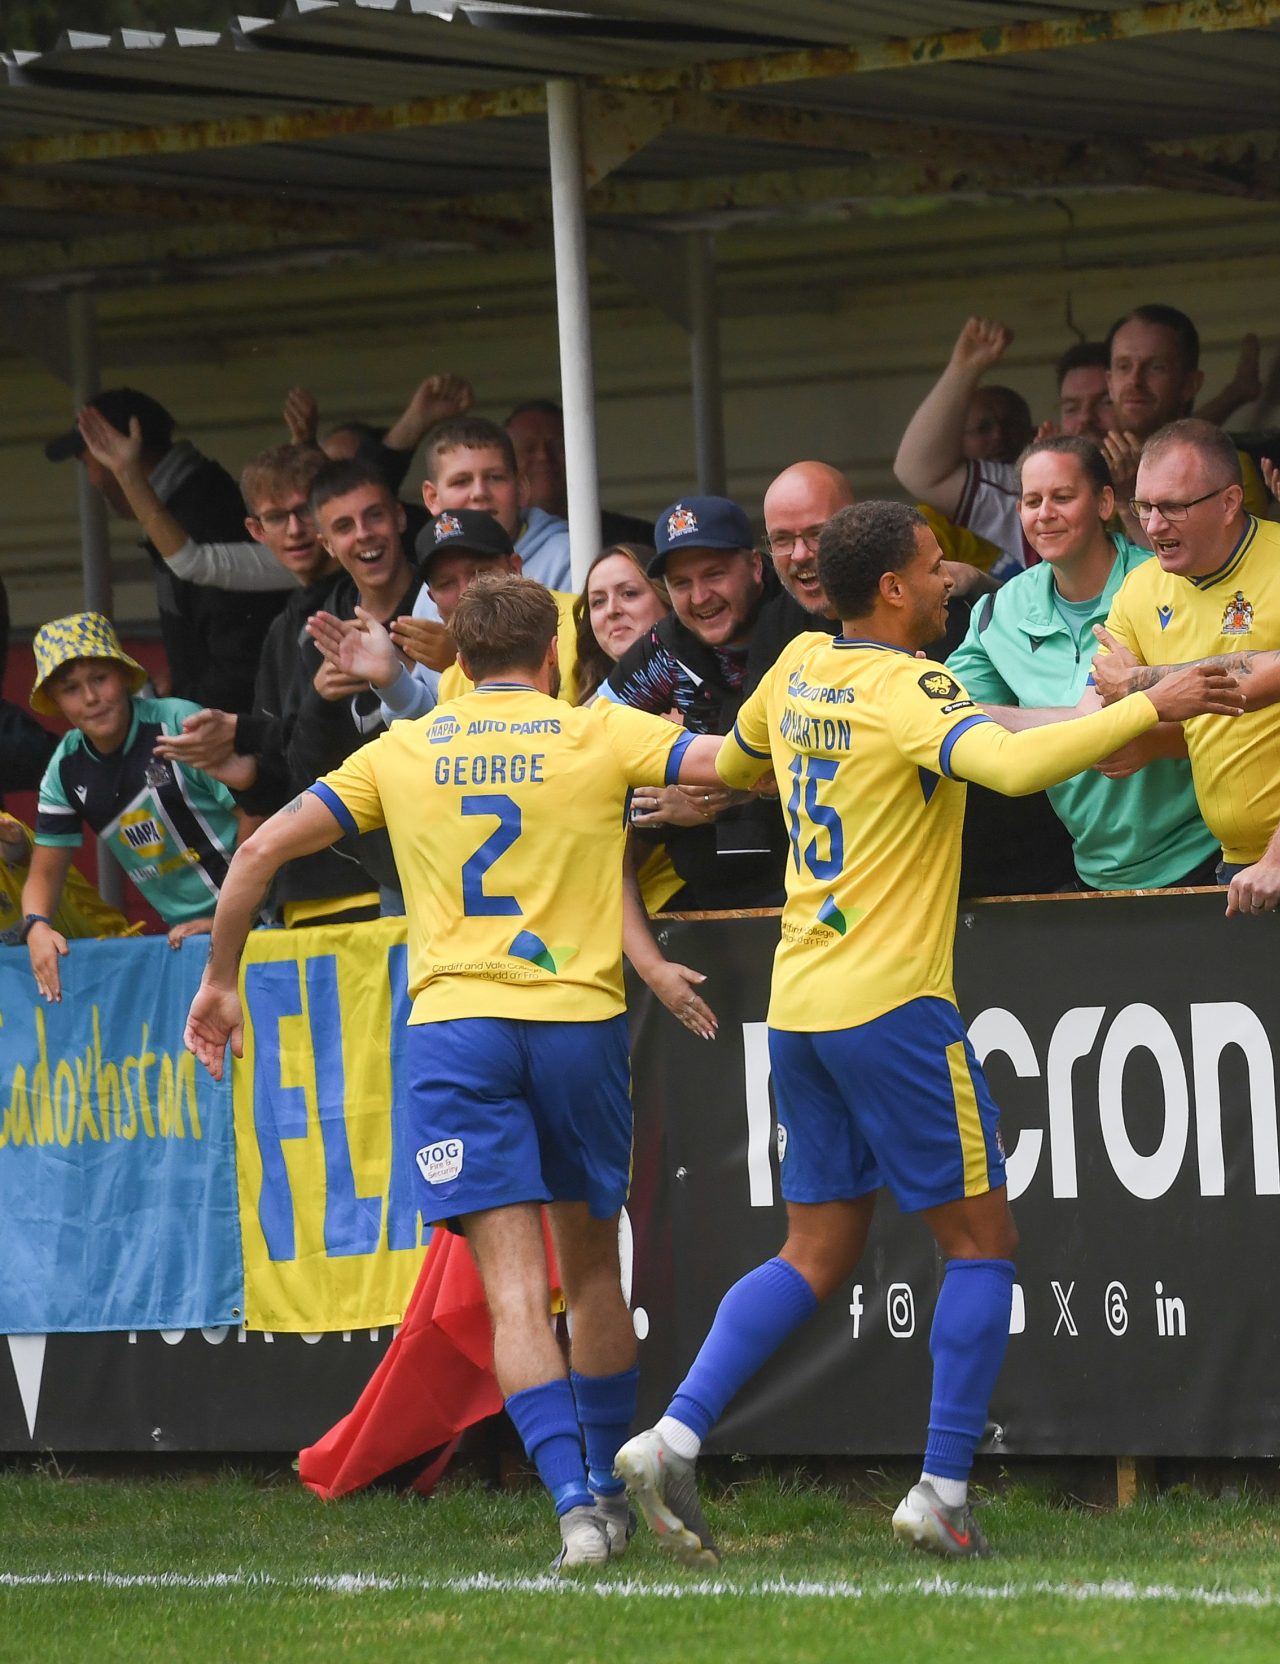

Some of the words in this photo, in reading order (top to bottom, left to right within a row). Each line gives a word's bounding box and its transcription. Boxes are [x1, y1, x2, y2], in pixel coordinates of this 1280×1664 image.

[819, 687, 855, 704] PARTS
[430, 722, 455, 738] NAPA
[466, 720, 506, 736] AUTO
[510, 719, 561, 734] PARTS
[780, 706, 851, 751] WHARTON
[434, 754, 545, 785] GEORGE
[787, 753, 844, 881] 15
[124, 820, 160, 847] NAPA
[460, 794, 524, 917] 2
[432, 962, 463, 973] Cardiff
[464, 962, 484, 970] and
[485, 961, 506, 970] Vale
[418, 1142, 459, 1166] VOG
